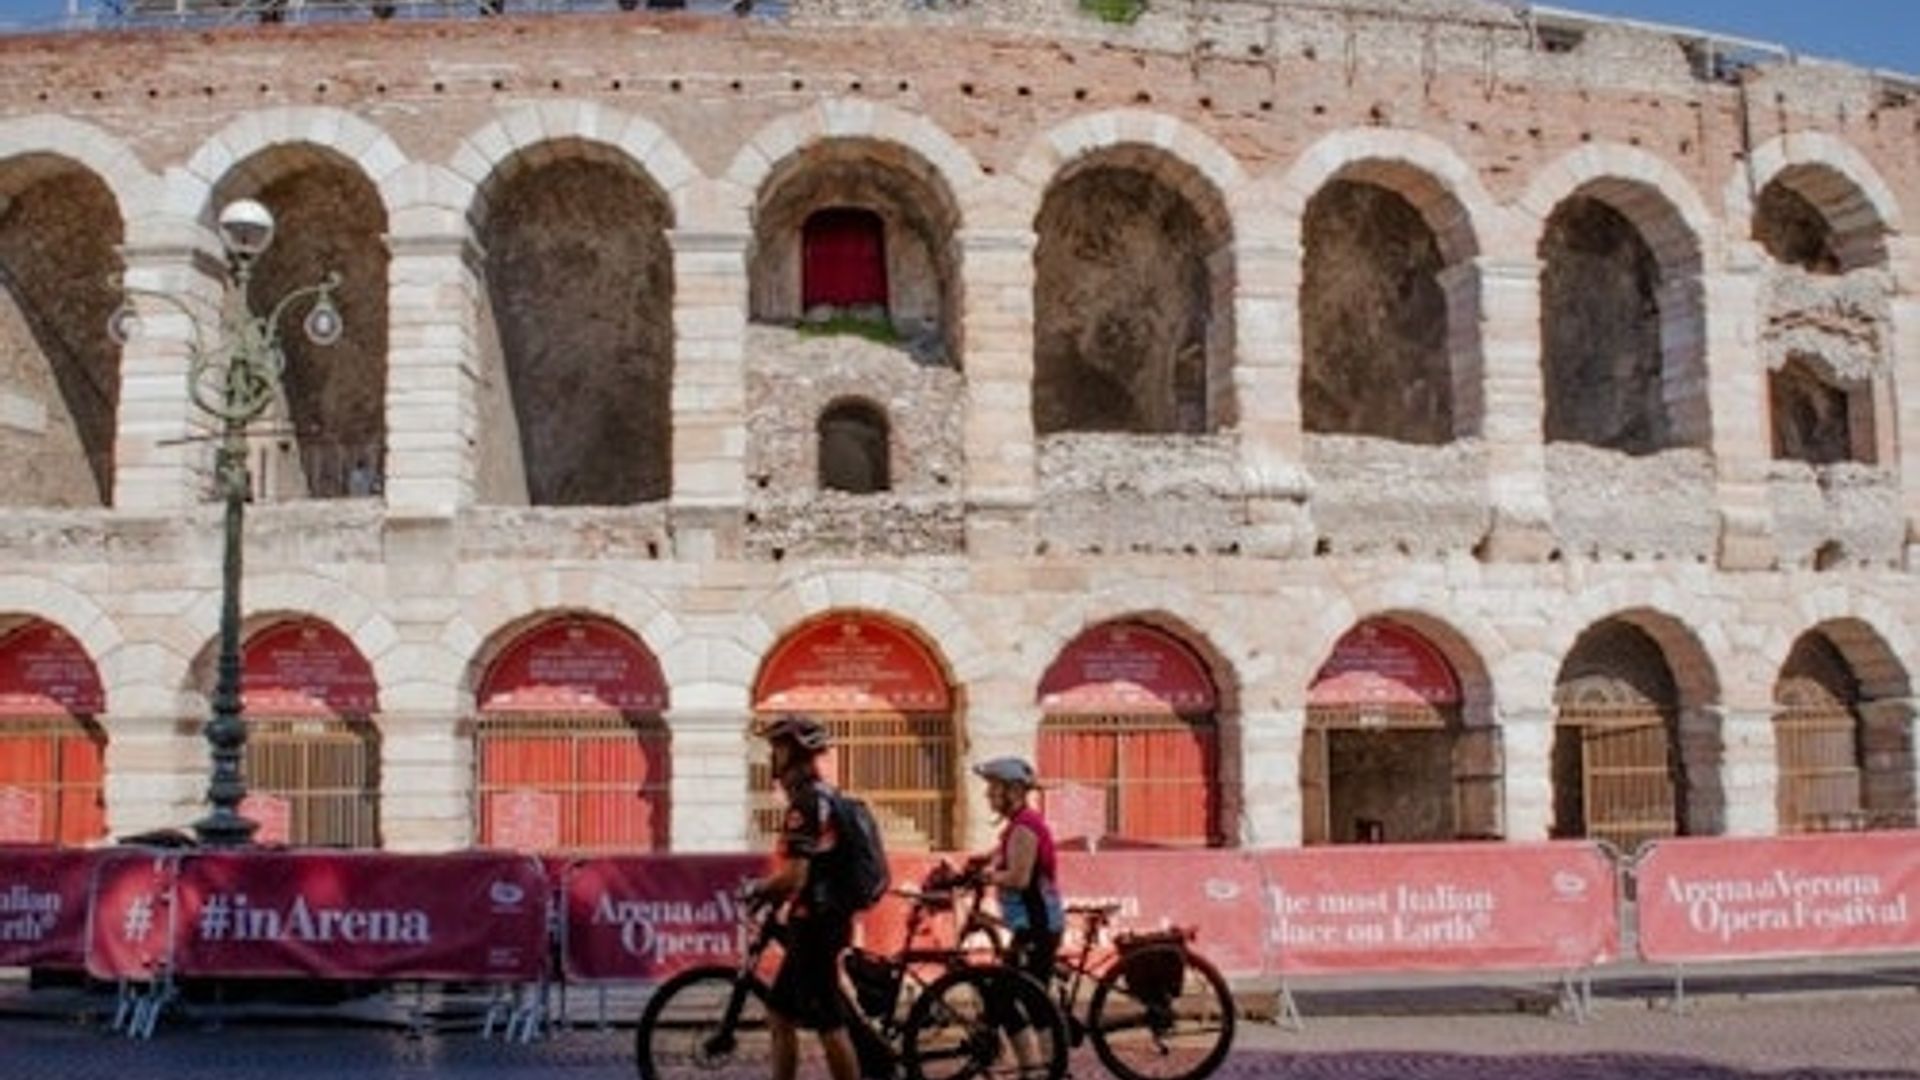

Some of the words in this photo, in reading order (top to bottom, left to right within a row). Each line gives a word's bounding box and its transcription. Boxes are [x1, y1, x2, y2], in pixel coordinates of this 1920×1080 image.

[1319, 890, 1388, 914] most
[1666, 874, 1752, 904] Arena
[201, 894, 431, 943] #inArena
[592, 891, 693, 925] Arena
[1688, 897, 1788, 943] Opera
[1793, 892, 1908, 929] Festival
[621, 917, 731, 965] Opera
[1346, 922, 1385, 943] on
